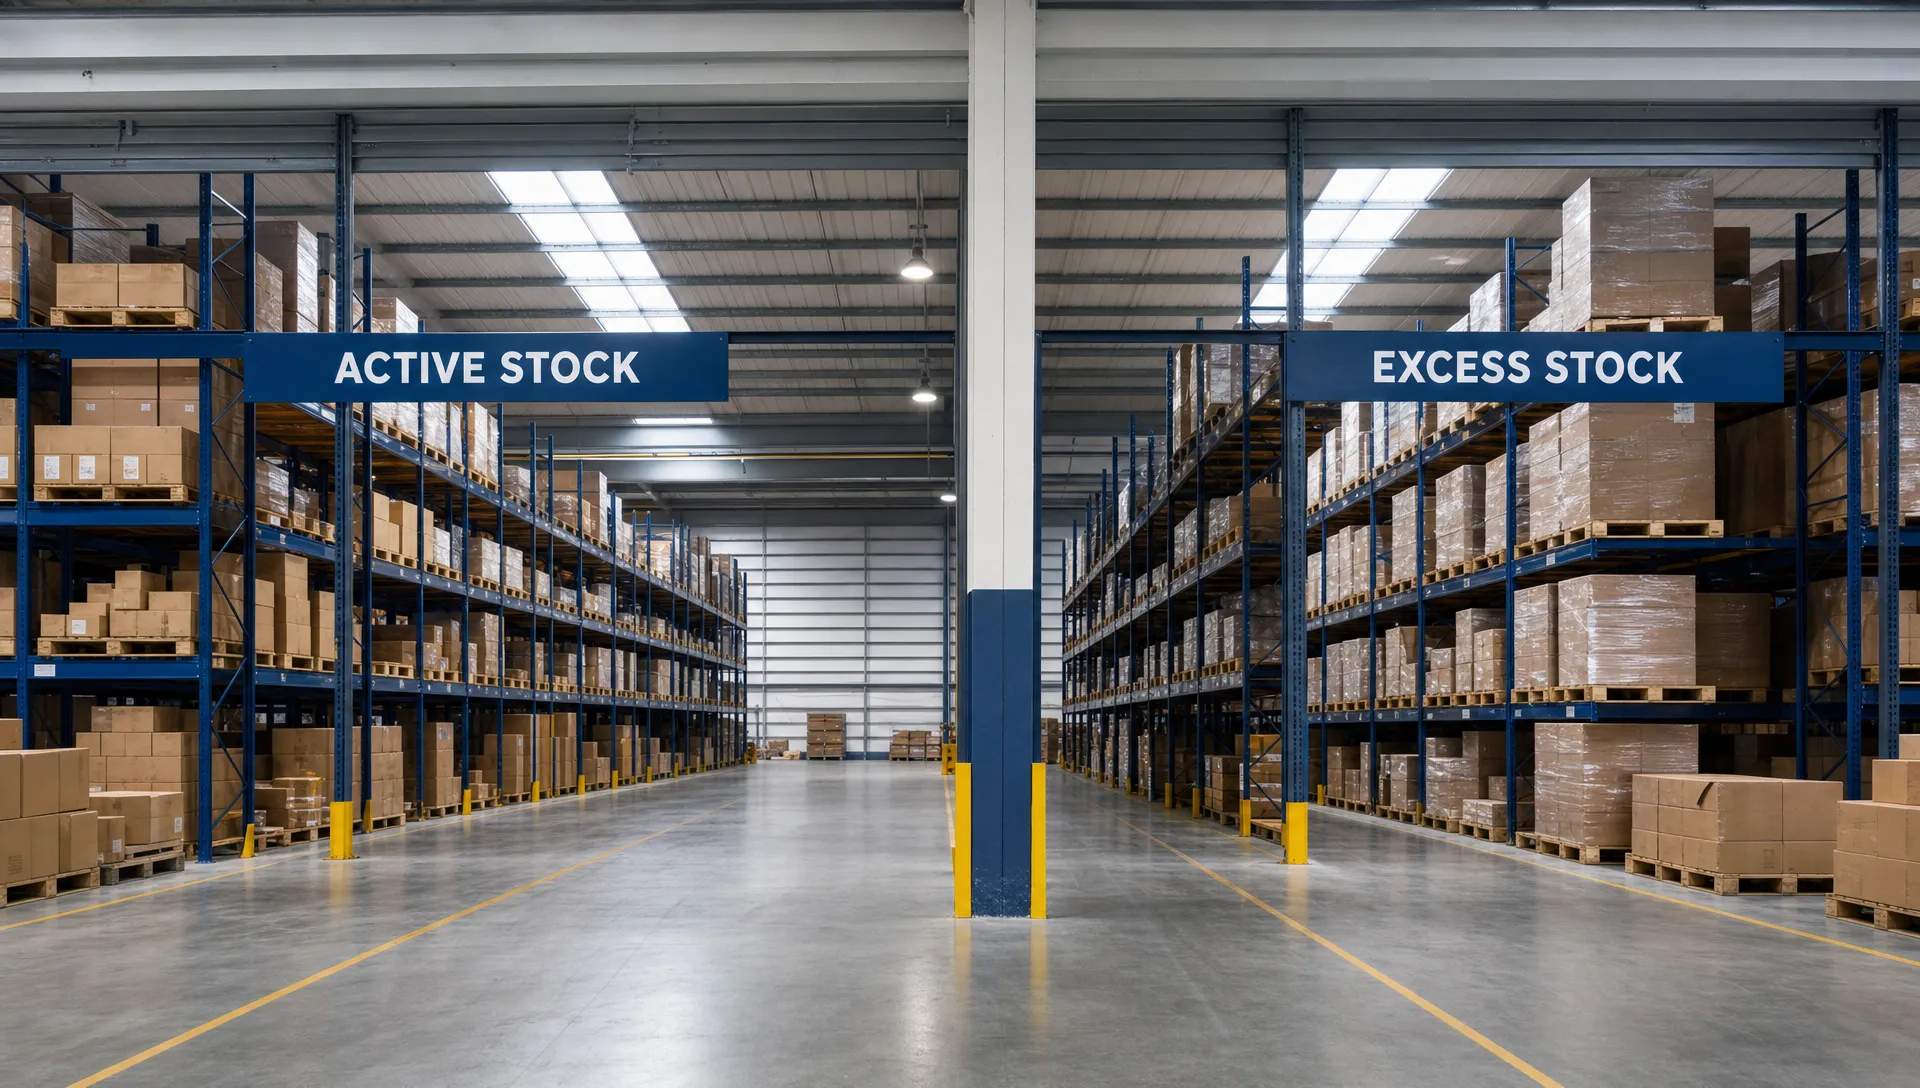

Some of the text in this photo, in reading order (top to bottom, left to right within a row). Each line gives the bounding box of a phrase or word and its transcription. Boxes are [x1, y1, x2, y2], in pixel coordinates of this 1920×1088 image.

[334, 350, 640, 384] ACTIVE STOCK
[1373, 350, 1684, 384] EXCESS STOCK
